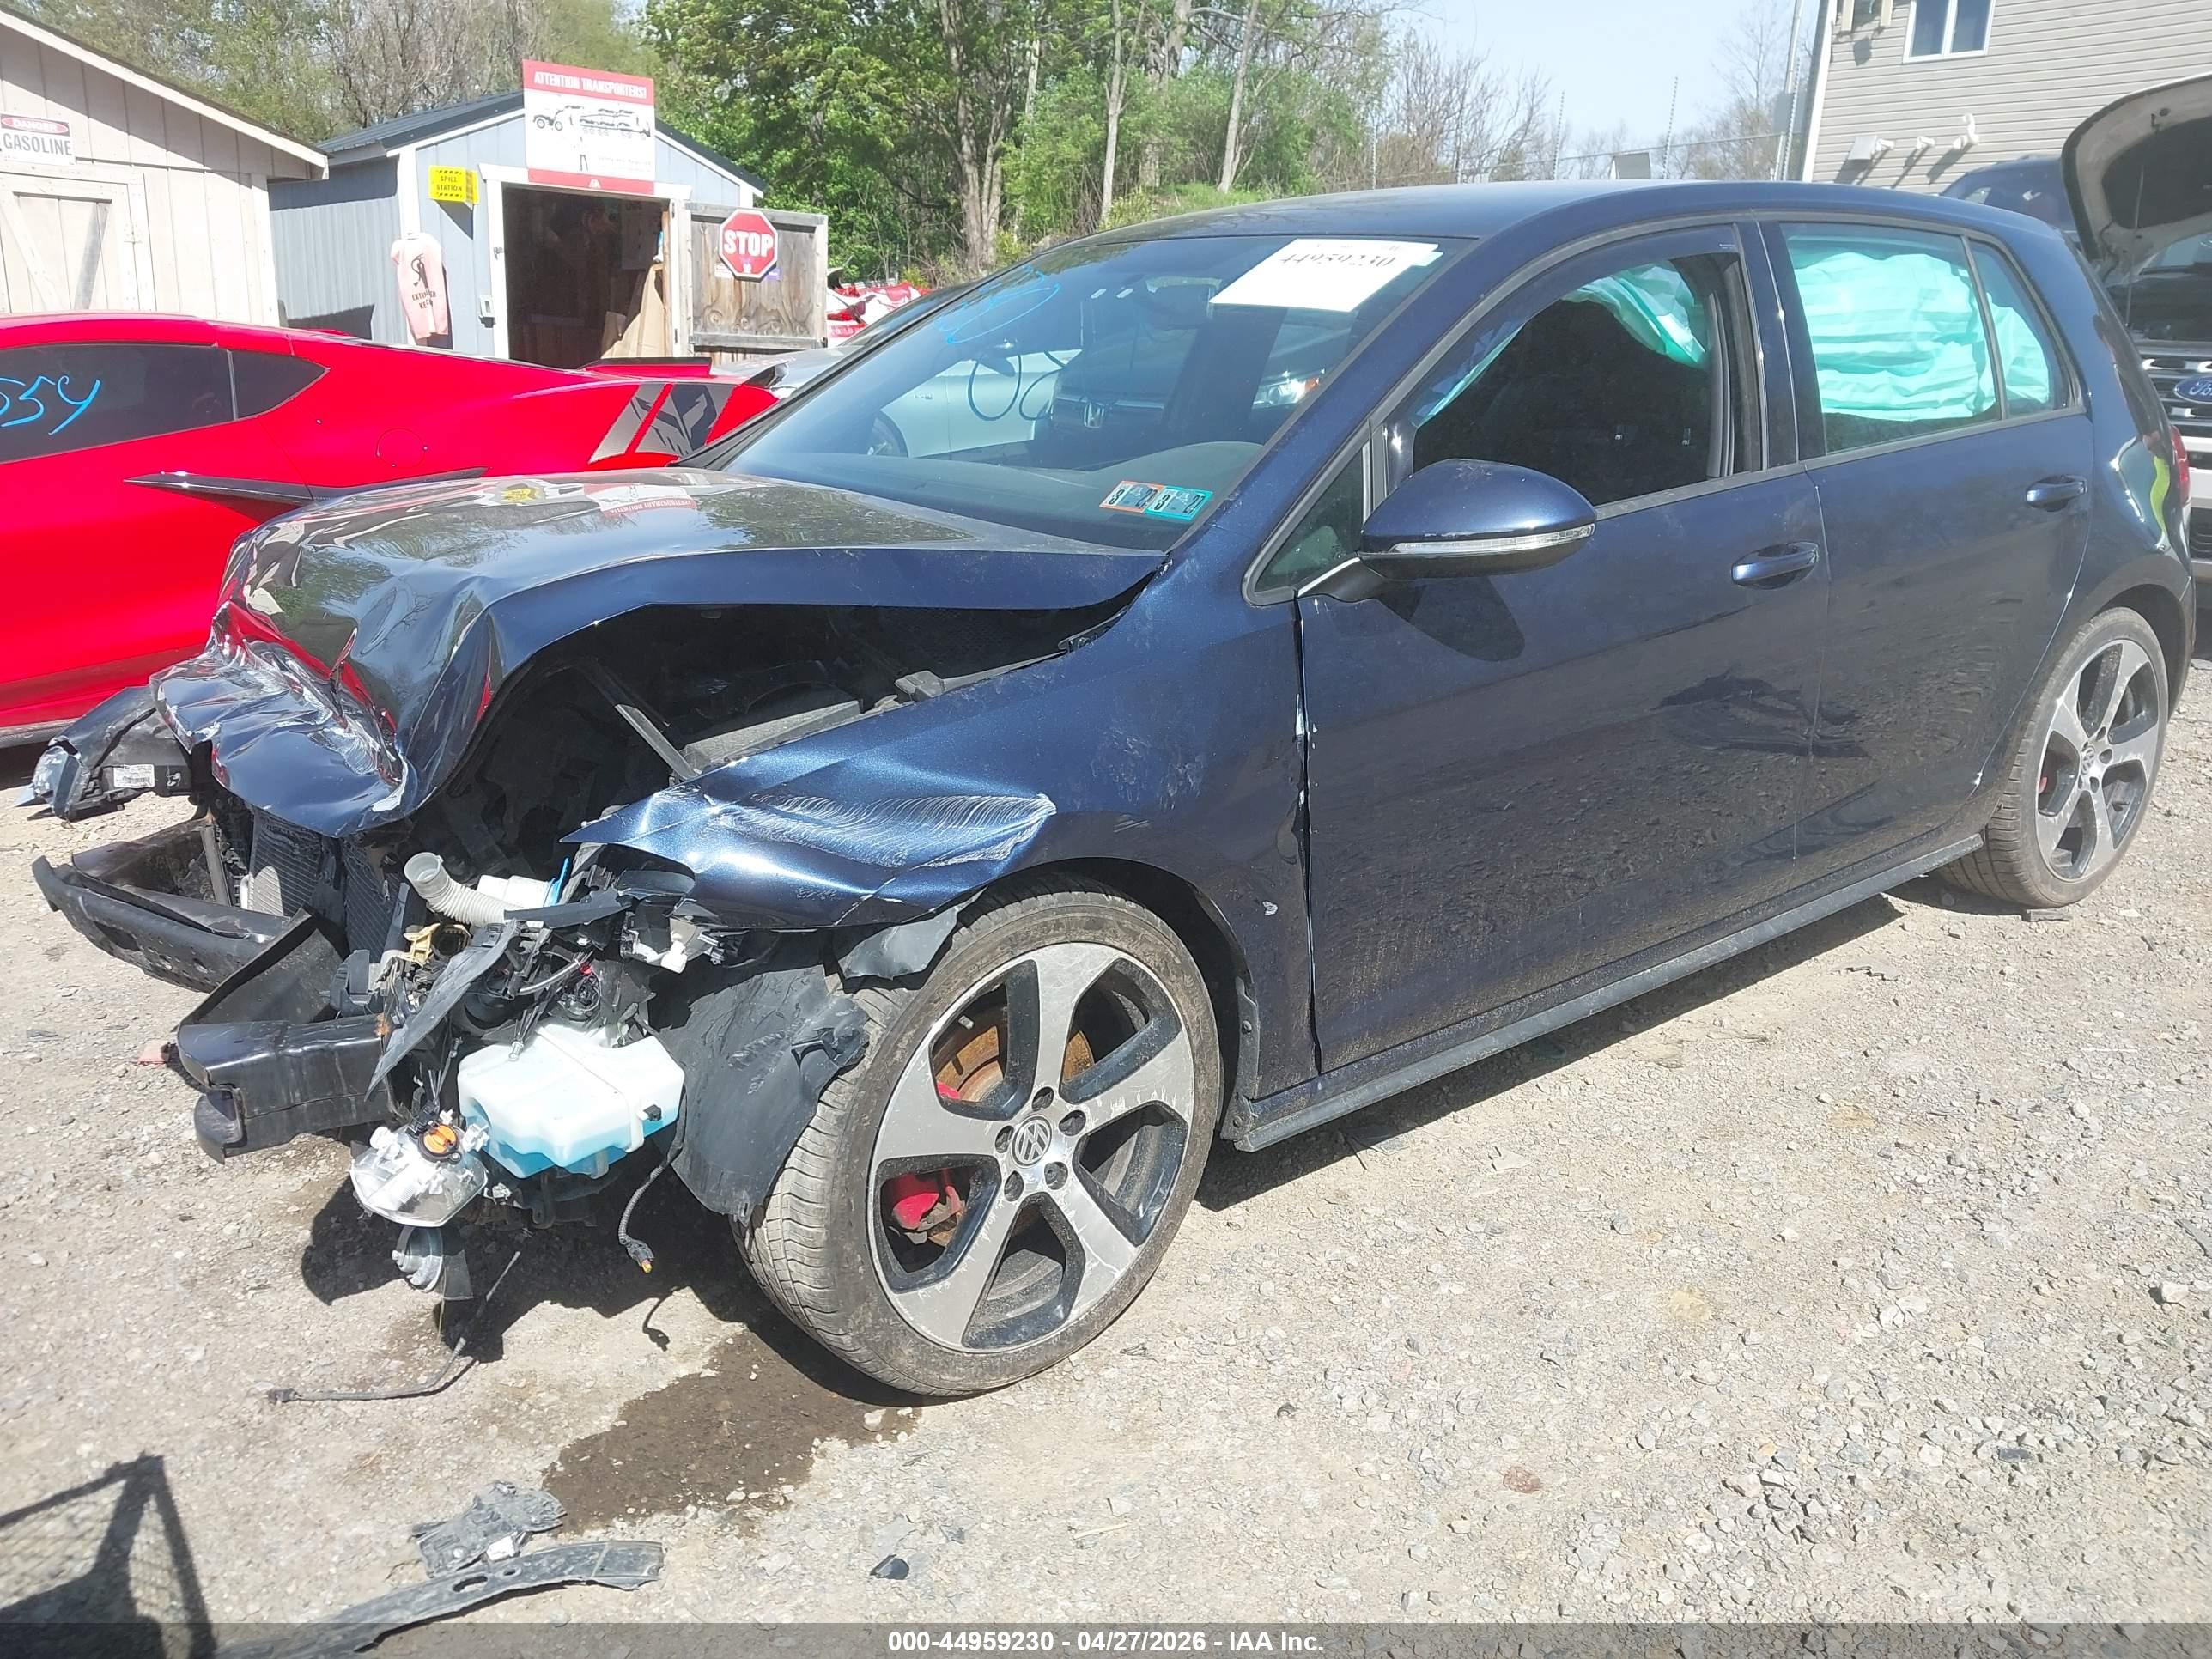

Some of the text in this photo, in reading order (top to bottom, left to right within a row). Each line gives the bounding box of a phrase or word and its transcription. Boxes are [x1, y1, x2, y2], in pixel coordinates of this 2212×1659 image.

[534, 71, 647, 99] ATTENTION TRANSPORTERS!
[3, 133, 72, 155] GASOLINE
[723, 229, 774, 258] STOP
